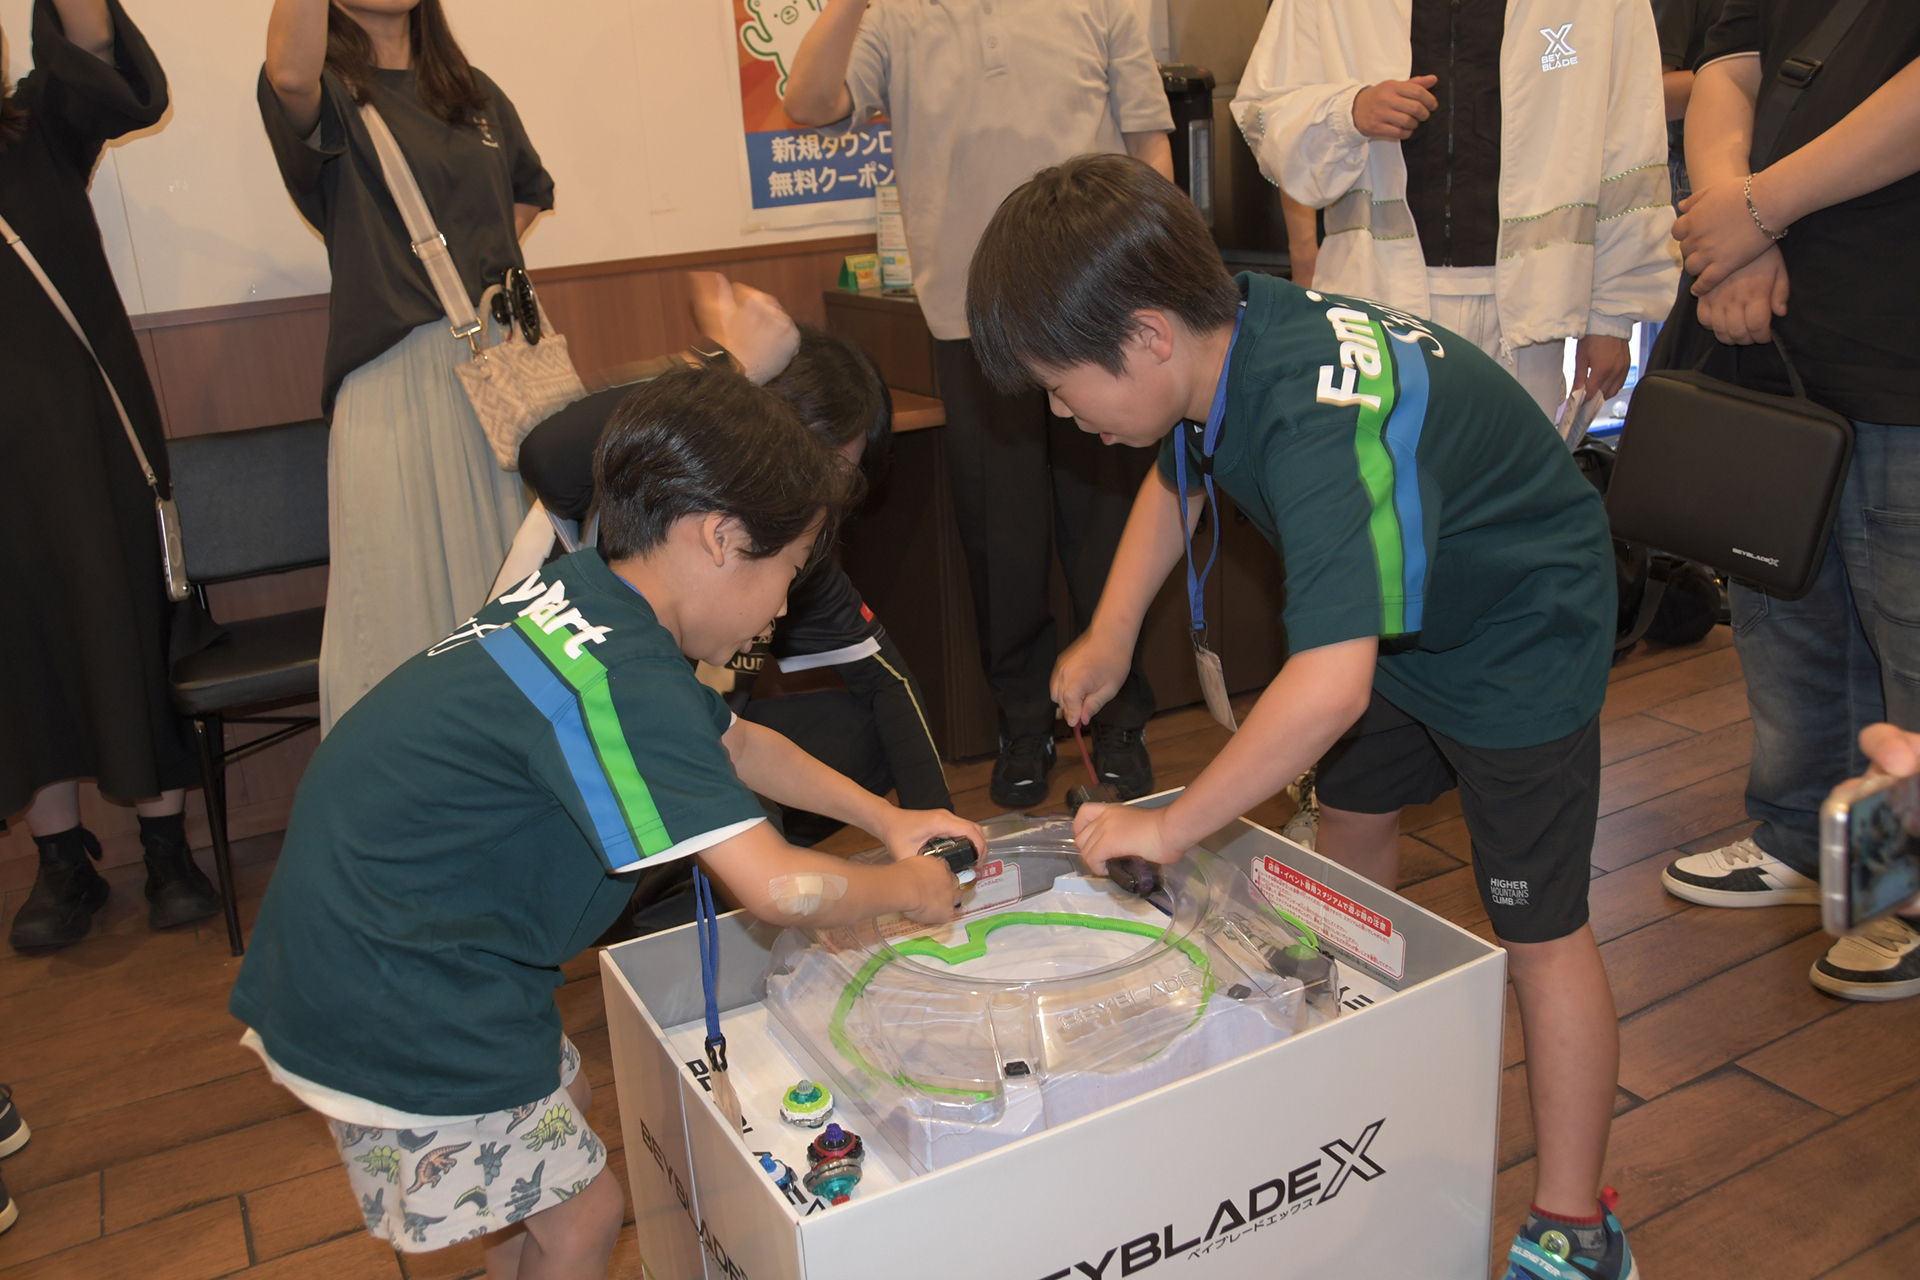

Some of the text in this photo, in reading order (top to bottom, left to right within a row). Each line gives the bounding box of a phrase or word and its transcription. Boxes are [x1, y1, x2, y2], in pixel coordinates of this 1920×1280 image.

[1541, 52, 1561, 63] BEY
[1542, 56, 1578, 72] BLADE
[768, 160, 895, 198] 無料クーポン
[1490, 877, 1528, 889] HIGHER
[1490, 886, 1529, 898] MOUNTAINS
[1492, 895, 1514, 906] CLIMB
[1187, 1198, 1314, 1261] ベイブレードエックス
